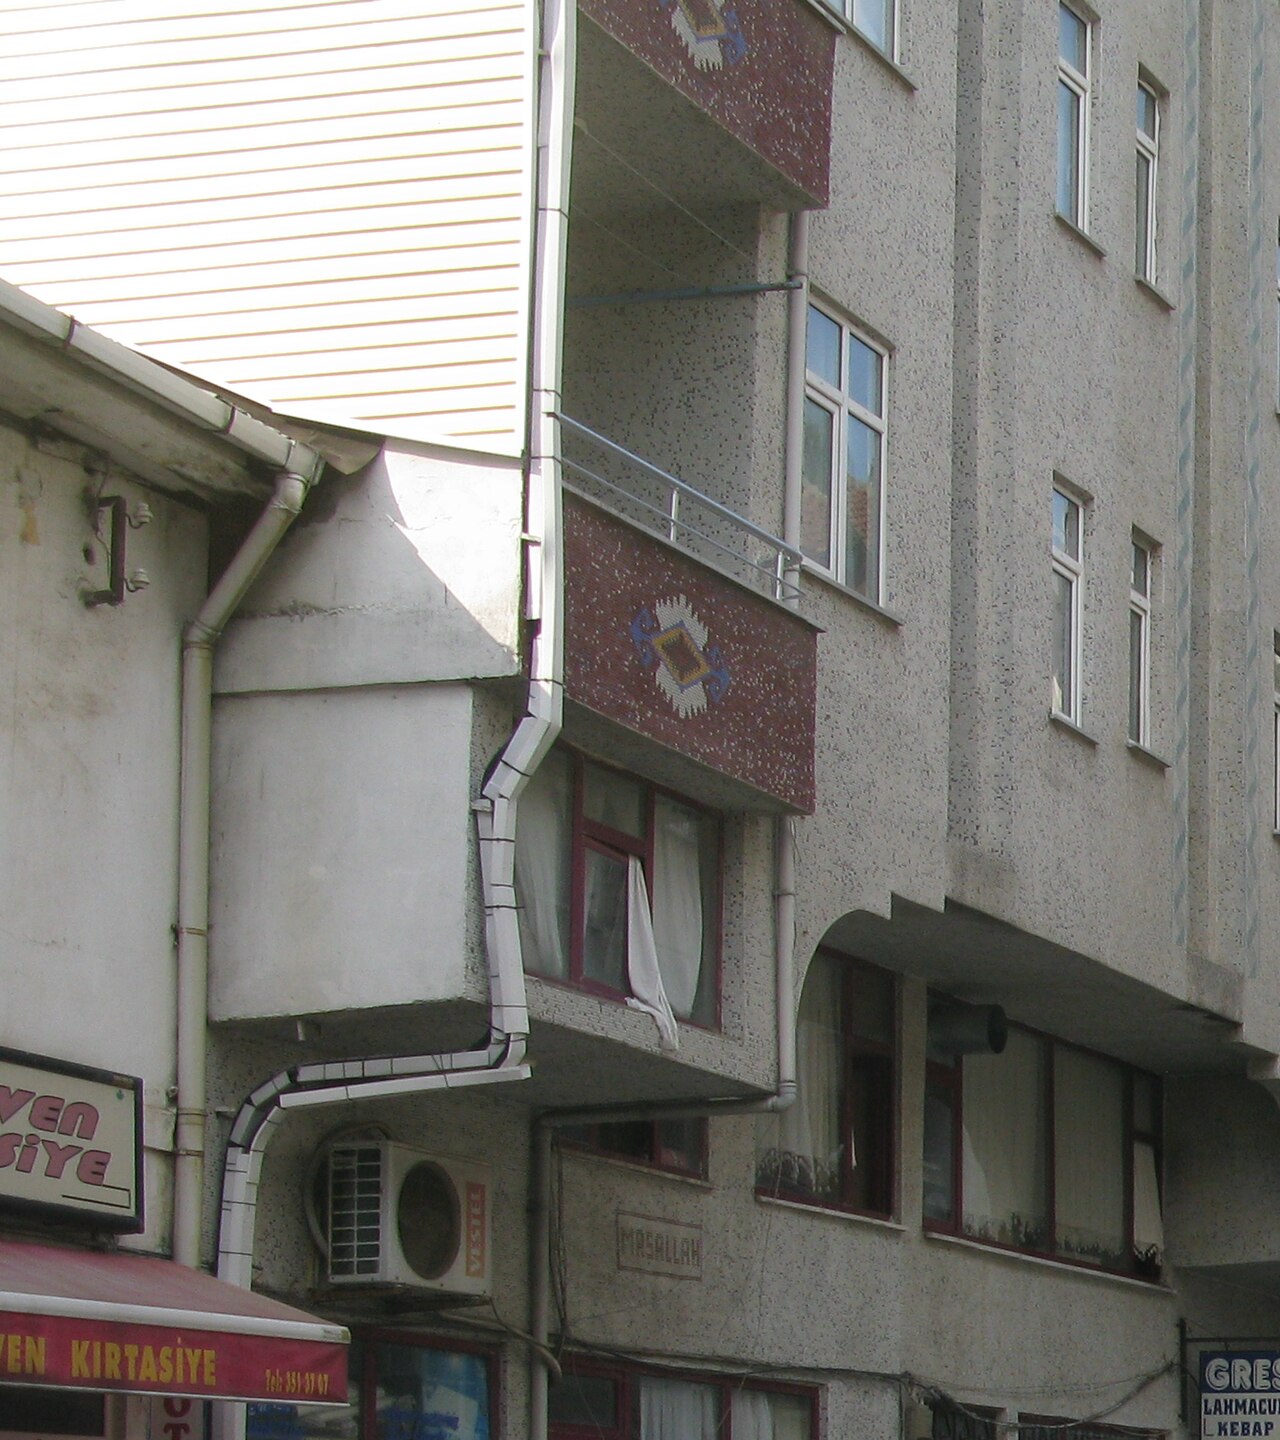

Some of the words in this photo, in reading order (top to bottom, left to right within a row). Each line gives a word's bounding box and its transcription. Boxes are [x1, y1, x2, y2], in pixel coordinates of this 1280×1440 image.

[0, 1333, 46, 1375] EN
[70, 1336, 217, 1386] KIRTASİYE
[1217, 1420, 1275, 1437] KEBAP
